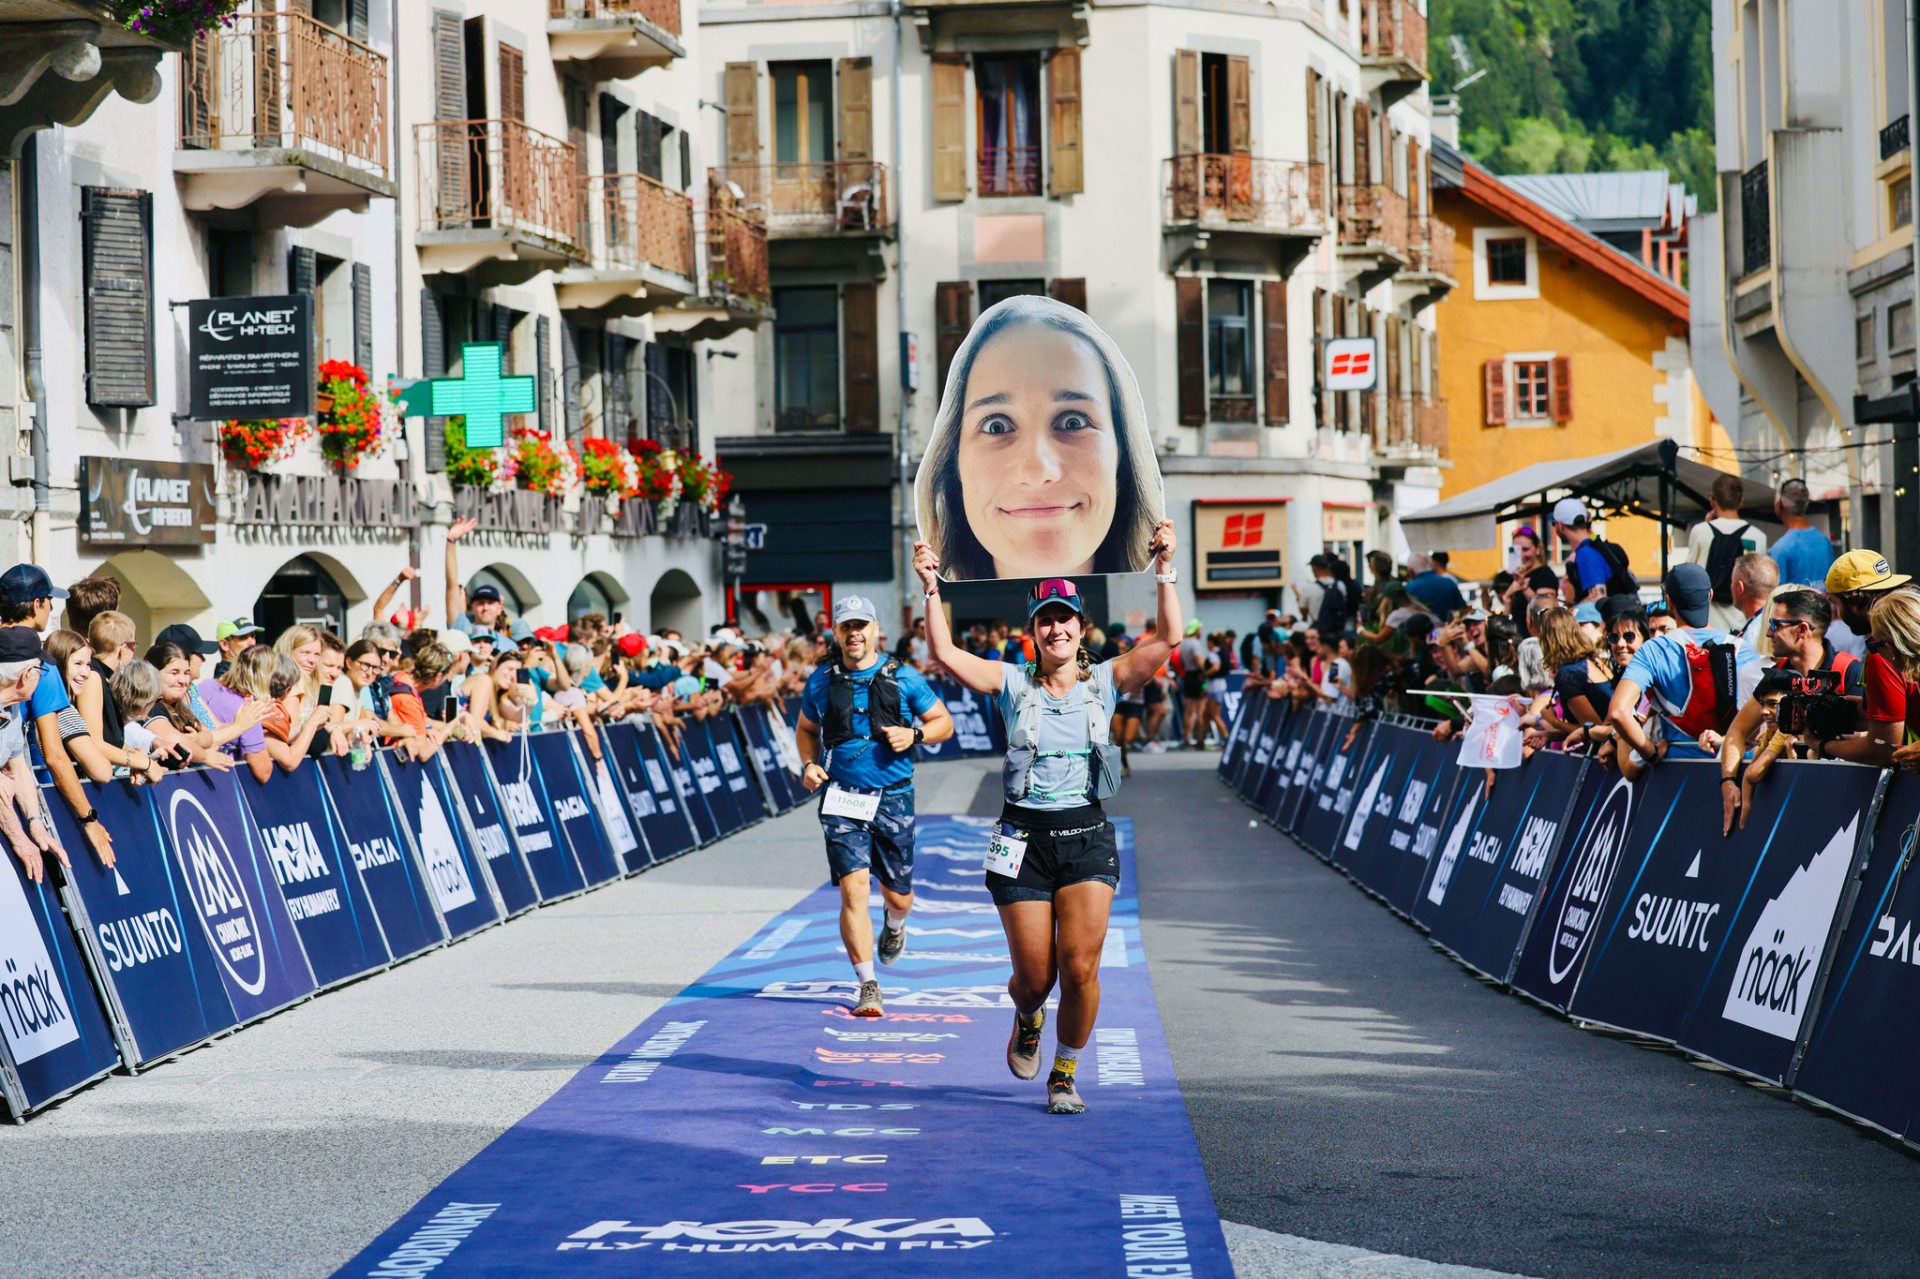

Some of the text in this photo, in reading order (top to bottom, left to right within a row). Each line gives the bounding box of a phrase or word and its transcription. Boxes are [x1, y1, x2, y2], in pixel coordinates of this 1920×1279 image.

[218, 310, 294, 325] PLANET
[241, 324, 296, 336] HI-TECH
[1725, 652, 1734, 696] SALOMON
[837, 796, 866, 808] 11608
[262, 821, 330, 885] HOKA
[350, 836, 401, 871] DACIA
[1510, 815, 1557, 880] HOKA
[99, 907, 182, 972] SUUNTO
[1738, 928, 1811, 1015] näak
[0, 957, 67, 1040] näak
[627, 1020, 709, 1059] MONT-BLANC
[1096, 1045, 1146, 1086] MONT-BLANC
[813, 1080, 920, 1088] PTL
[791, 1100, 918, 1111] TDS
[761, 1127, 921, 1136] MCC
[760, 1154, 889, 1165] ETC
[737, 1182, 889, 1194] YCC
[1119, 1193, 1182, 1219] MEET
[567, 1217, 996, 1241] HOKA
[1122, 1221, 1189, 1262] YOUR
[556, 1239, 993, 1254] FLY HUMAN FLY
